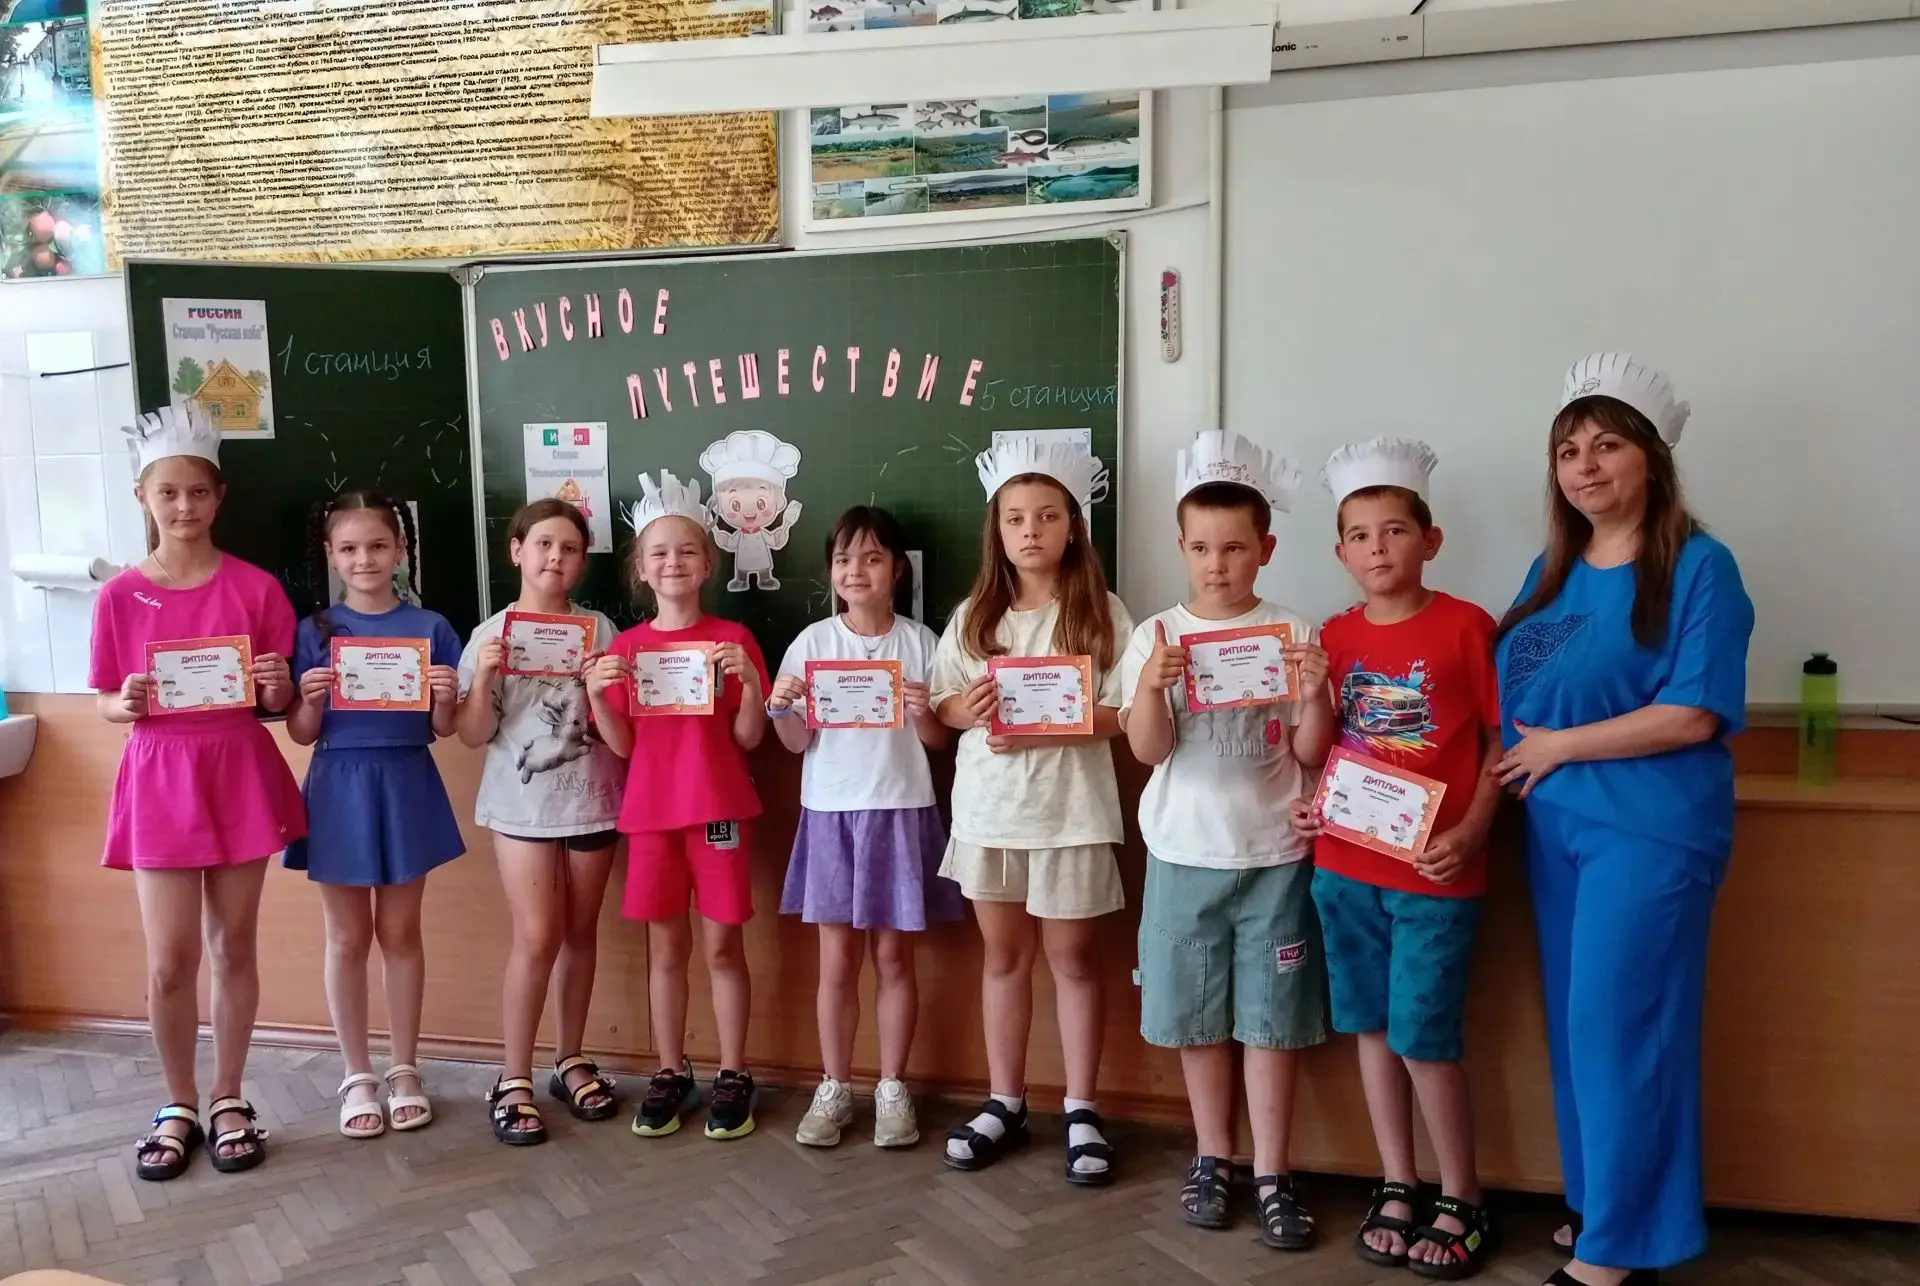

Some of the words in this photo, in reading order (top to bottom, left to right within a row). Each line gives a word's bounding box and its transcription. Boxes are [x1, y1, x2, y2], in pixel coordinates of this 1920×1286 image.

[489, 288, 670, 361] ВКУСНОЕ
[277, 334, 293, 375] 1
[304, 346, 432, 381] станция
[626, 344, 984, 420] ПУТЕШЕСТВИЕ
[980, 378, 1005, 412] 5
[1009, 384, 1117, 413] станция
[533, 627, 568, 636] ДИПЛОМ
[1219, 643, 1260, 656] ДИПЛОМ
[181, 654, 220, 664] ДИПЛОМ
[659, 656, 690, 664] ДИПЛОМ
[837, 675, 874, 683] ДИПЛОМ
[1022, 672, 1061, 680] ДИПЛОМ
[554, 771, 588, 797] My
[1362, 775, 1406, 797] ДИПЛОМ
[710, 821, 728, 834] TB
[710, 833, 729, 841] sport
